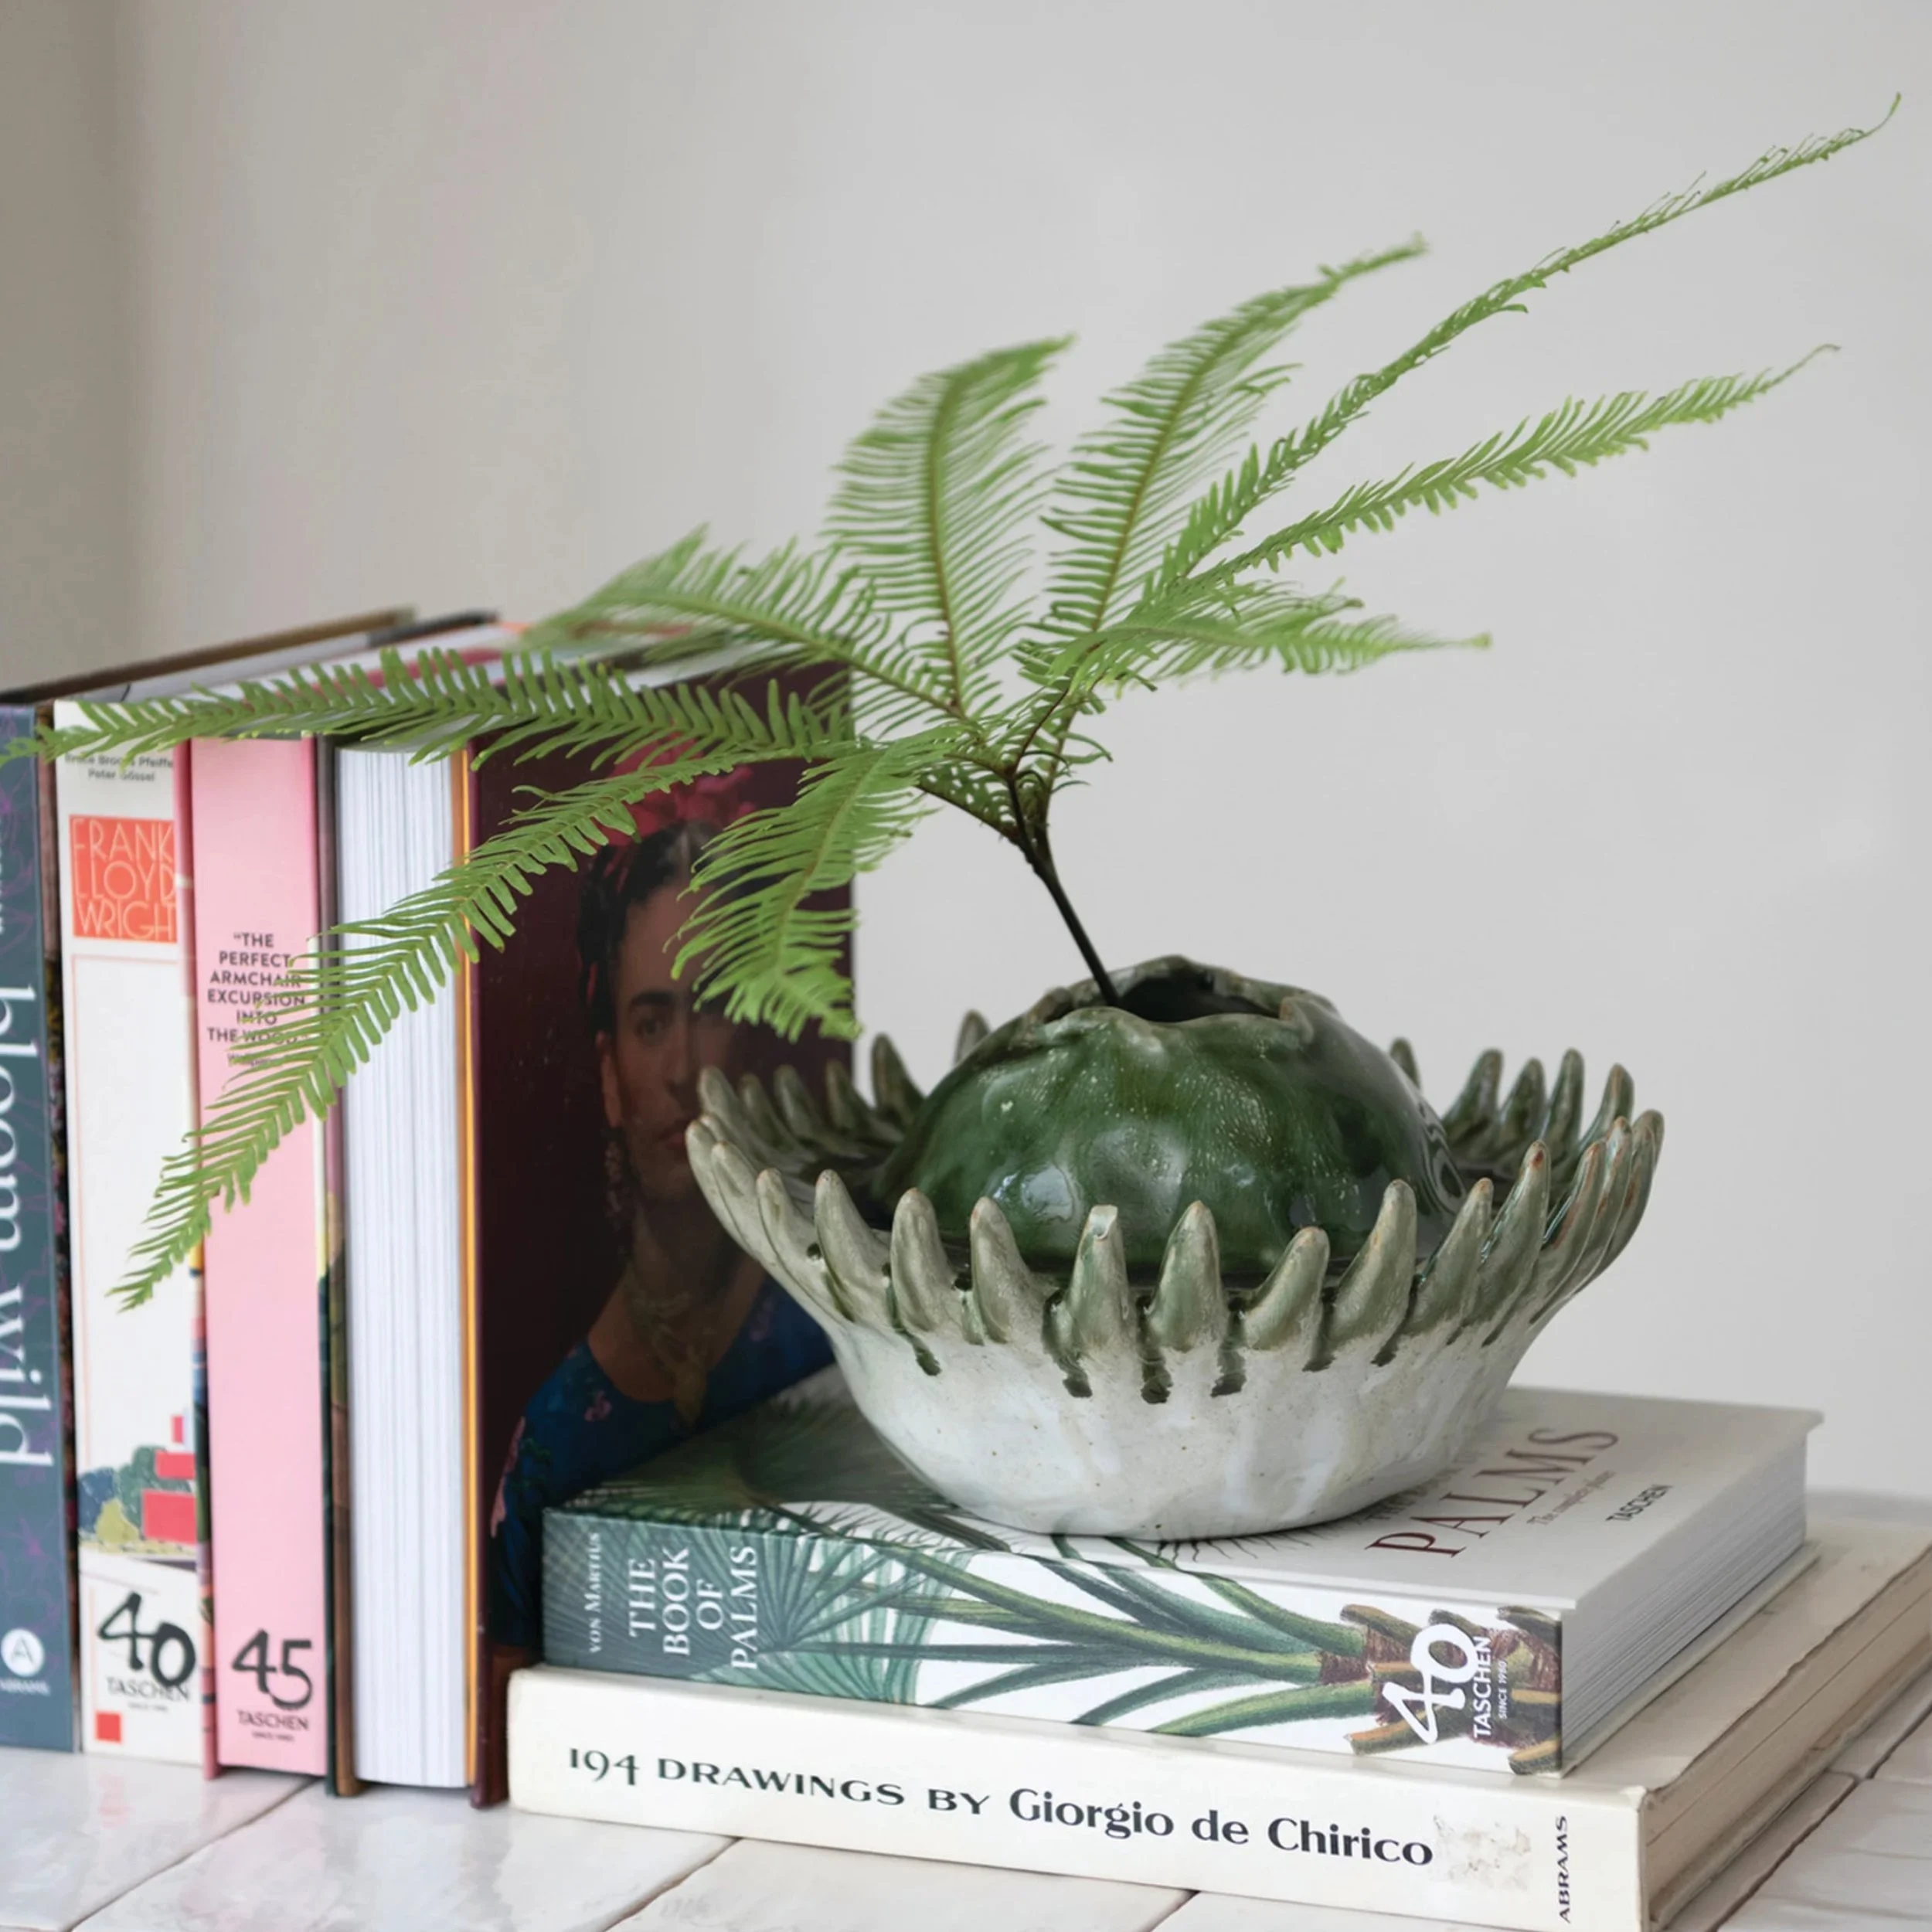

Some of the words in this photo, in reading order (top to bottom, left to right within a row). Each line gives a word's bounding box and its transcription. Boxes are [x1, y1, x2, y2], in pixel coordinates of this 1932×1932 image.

[72, 818, 174, 863] FRANK
[207, 988, 305, 1007] EXCURSION
[209, 969, 301, 989] ARMCHAIR
[219, 951, 291, 968] PERFECT
[206, 1026, 239, 1043] THE
[1364, 1429, 1619, 1557] PALMS
[628, 1558, 656, 1638] THE
[662, 1547, 691, 1656] BOOK
[696, 1579, 724, 1631] OF
[730, 1546, 758, 1669] PALMS
[97, 1592, 196, 1686] 40
[231, 1629, 313, 1710] 45
[236, 1709, 309, 1731] TASCHEN
[1382, 1624, 1478, 1744] 40
[1473, 1636, 1492, 1738] TASCHEN
[1498, 1687, 1509, 1719] SINCE
[568, 1747, 640, 1787] 194
[658, 1757, 905, 1806] DRAWINGS
[927, 1787, 991, 1815] BY
[1009, 1787, 1174, 1839] Giorgio
[1191, 1809, 1249, 1845] de
[1267, 1817, 1434, 1866] Chirico
[1555, 1815, 1571, 1924] ABRAMS
